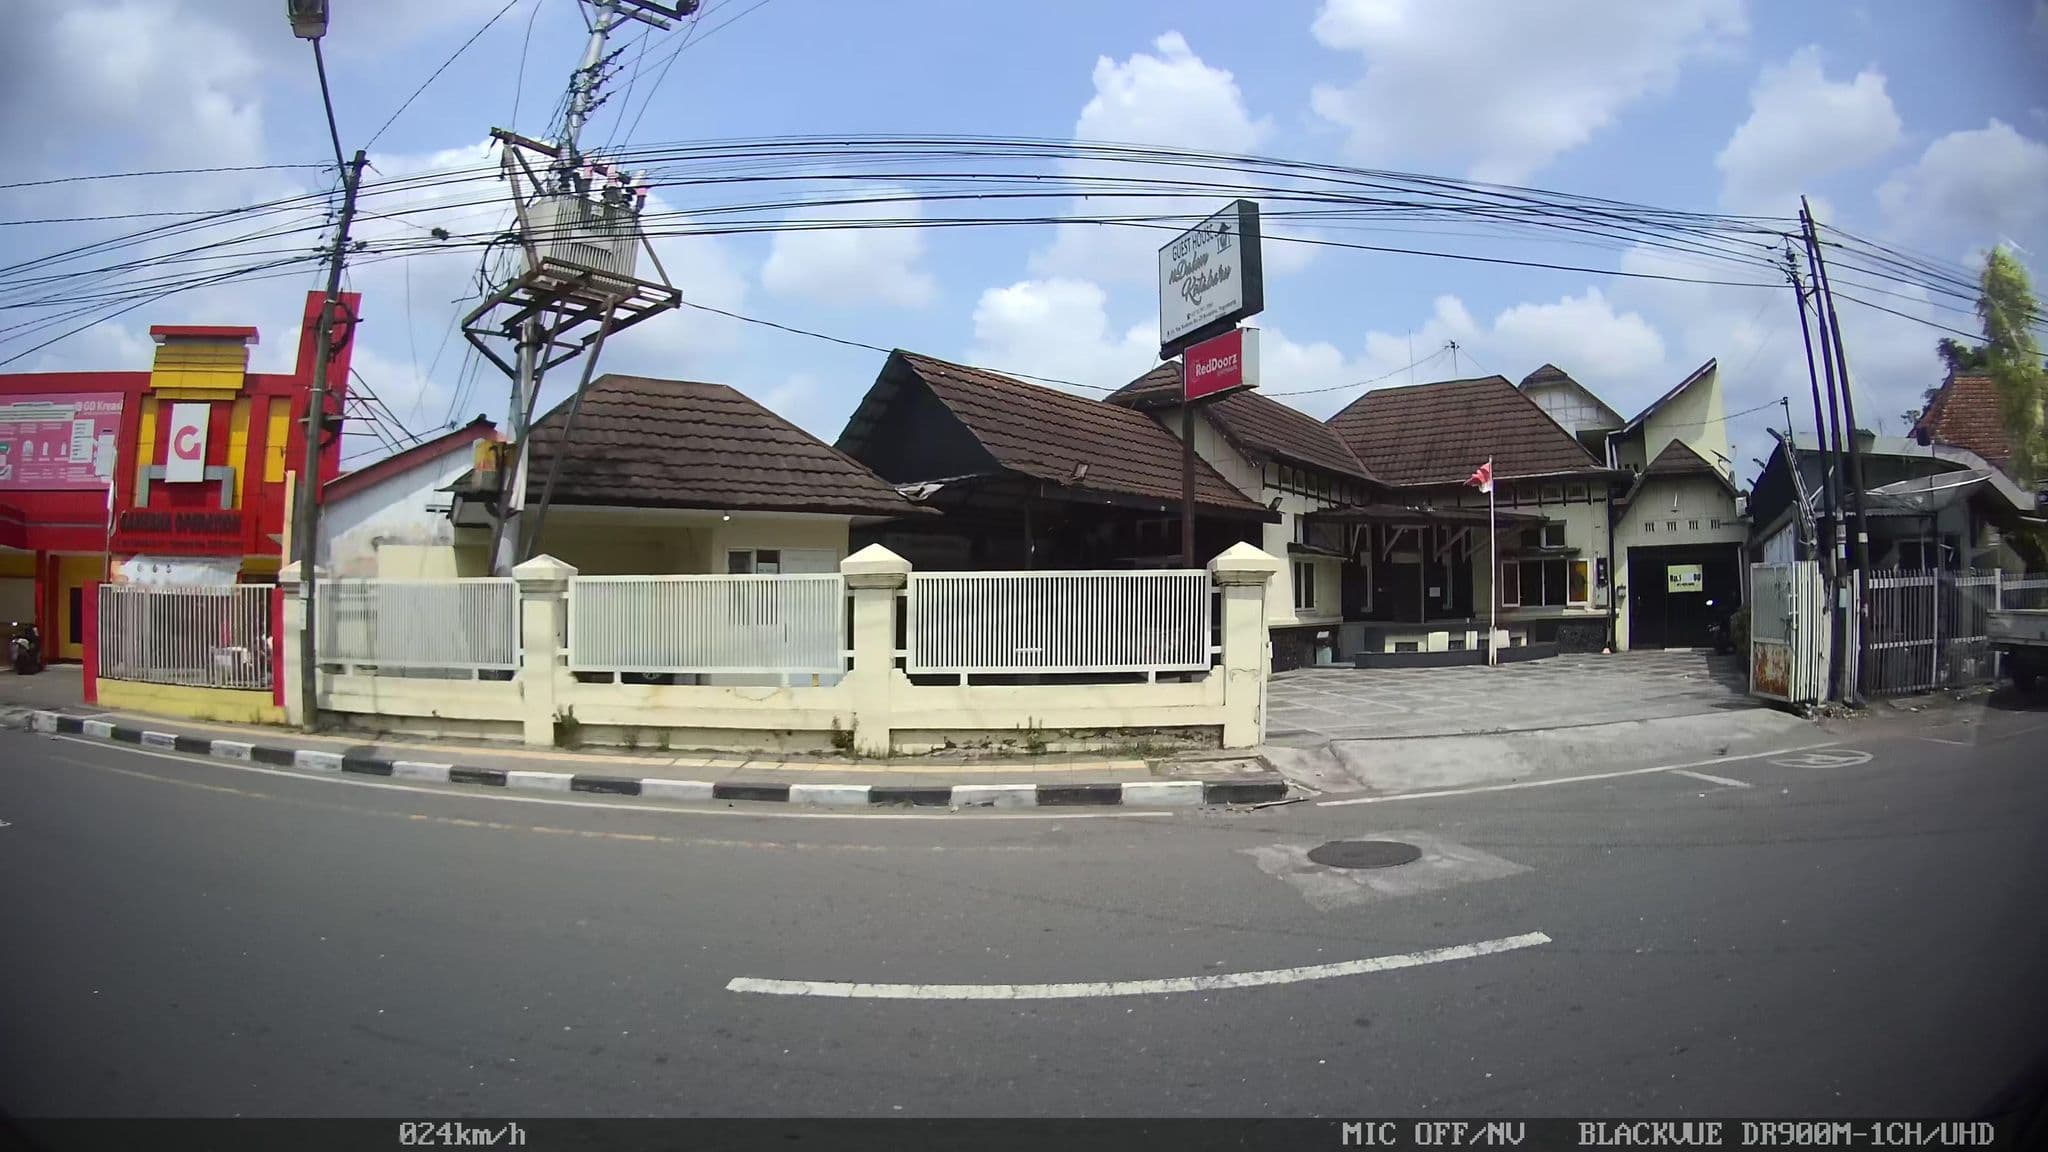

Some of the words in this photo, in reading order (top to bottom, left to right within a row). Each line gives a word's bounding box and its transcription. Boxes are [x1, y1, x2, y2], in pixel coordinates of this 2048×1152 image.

[1173, 237, 1191, 261] GUEST
[1192, 223, 1218, 249] HOUSE
[1195, 353, 1238, 377] RedDoorz
